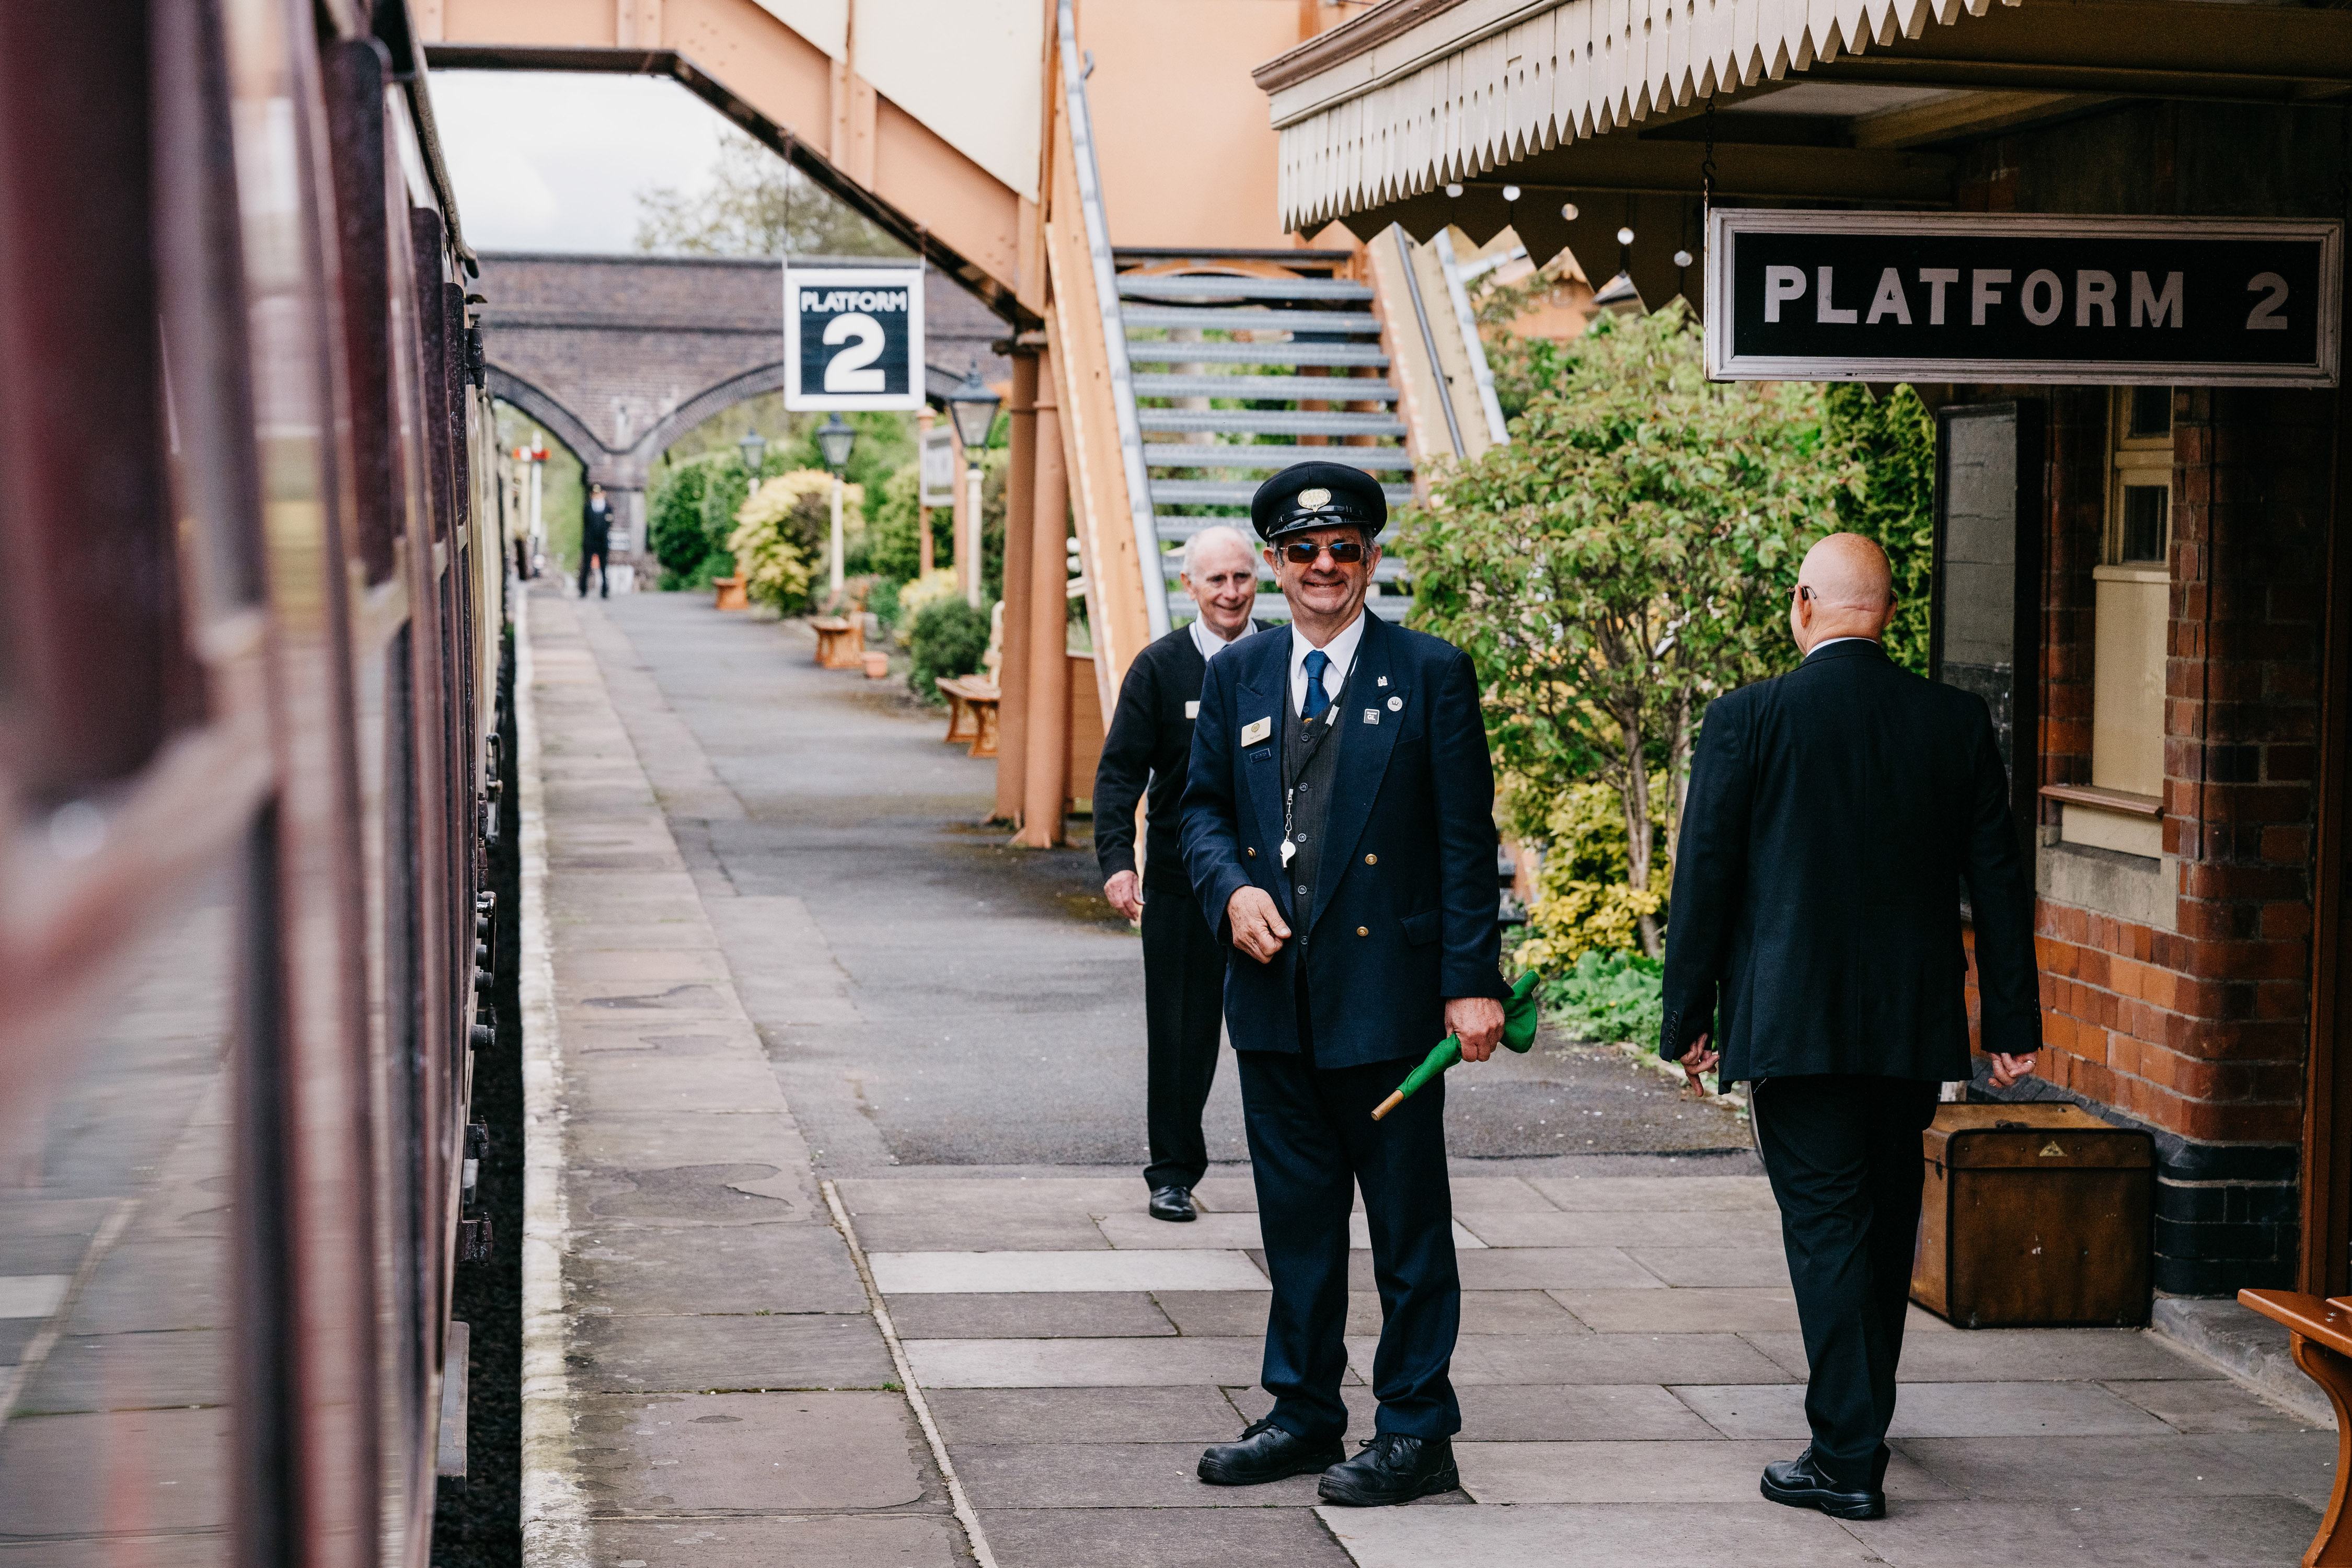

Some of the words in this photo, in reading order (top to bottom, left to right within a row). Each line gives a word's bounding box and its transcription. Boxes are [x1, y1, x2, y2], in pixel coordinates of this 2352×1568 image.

[801, 291, 907, 312] PLATFORM
[1765, 265, 2183, 328] PLATFORM
[2246, 272, 2289, 330] 2
[823, 312, 885, 392] 2
